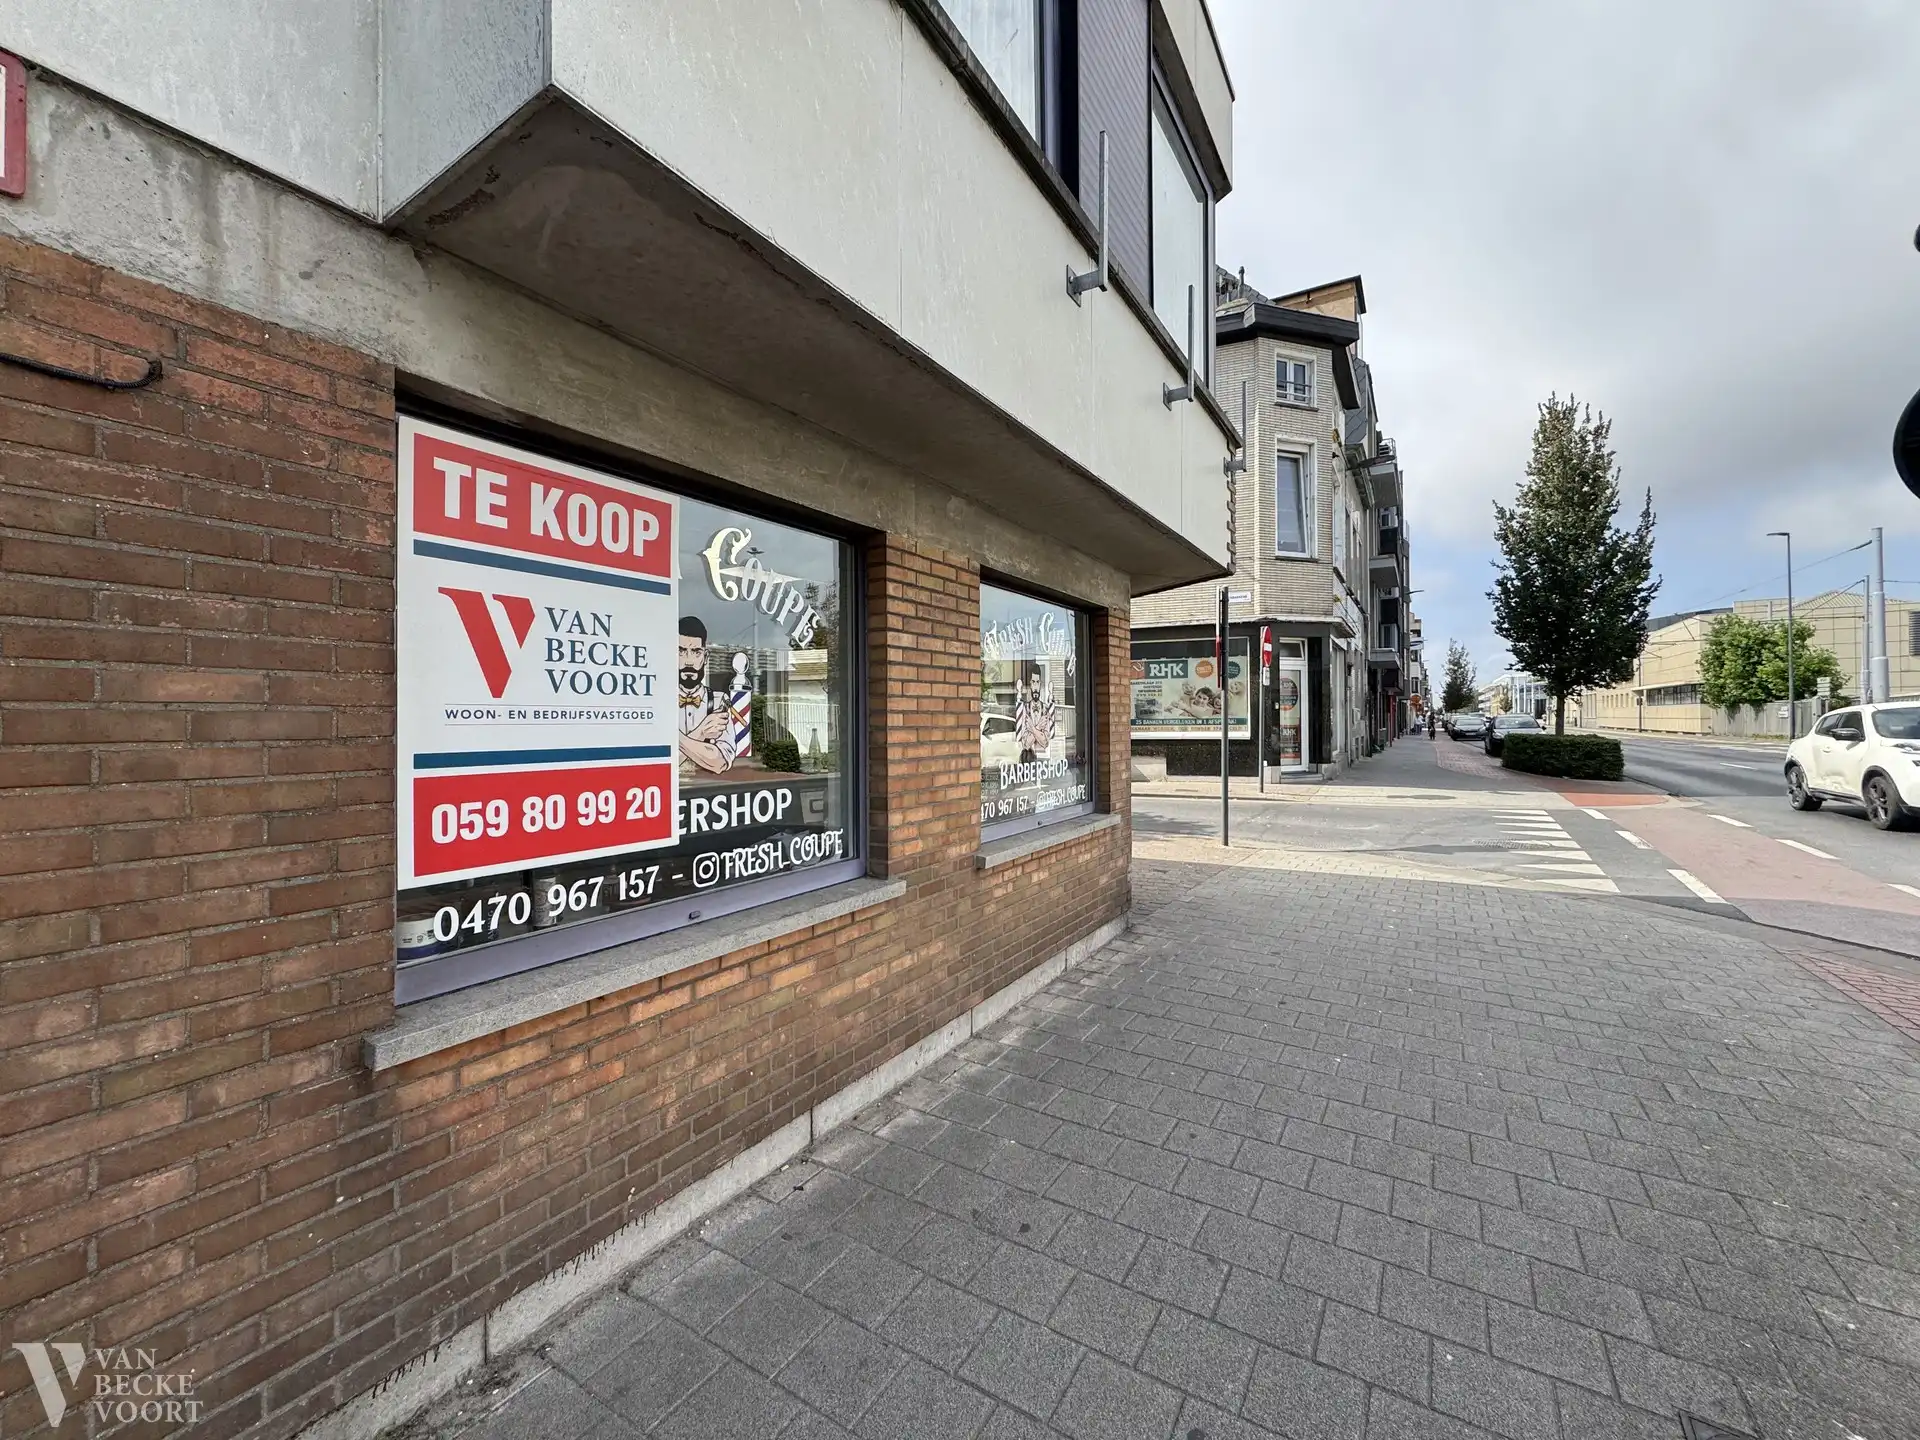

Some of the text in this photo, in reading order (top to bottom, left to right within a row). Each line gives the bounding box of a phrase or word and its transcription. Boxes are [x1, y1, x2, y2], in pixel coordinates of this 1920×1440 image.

[433, 456, 660, 557] TE KOOP
[703, 528, 820, 648] COUPE
[544, 607, 612, 637] VAN
[984, 619, 1034, 656] FRESH
[544, 637, 648, 668] BECKE
[544, 668, 656, 696] VOORT
[1149, 663, 1184, 680] RHK
[445, 709, 654, 719] WOON- EN BEDRIJFSVASTGOED
[999, 759, 1068, 790] BARBERSHOP
[432, 786, 661, 844] 059 80 99 20
[998, 798, 1014, 816] 967
[1016, 796, 1028, 812] 157
[433, 892, 531, 942] 0470
[547, 876, 604, 917] 967
[618, 865, 660, 900] 157
[721, 828, 844, 880] FRESH_COUPE
